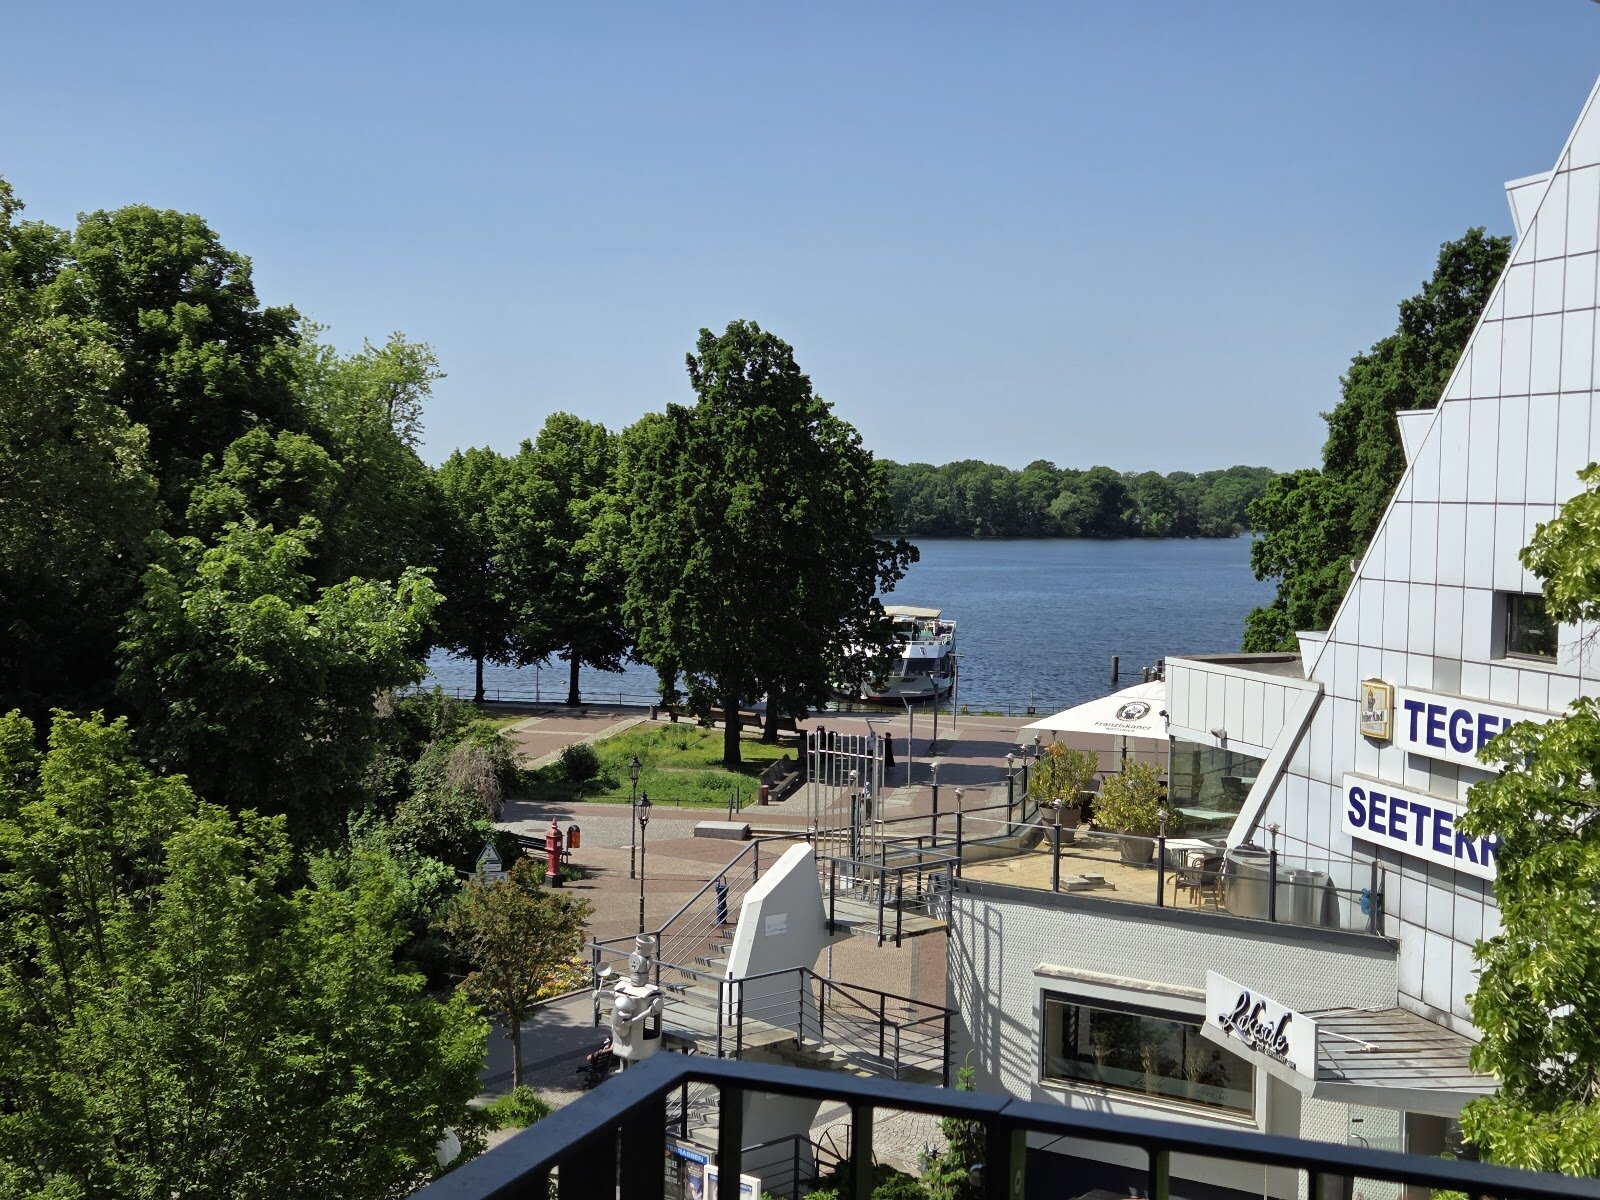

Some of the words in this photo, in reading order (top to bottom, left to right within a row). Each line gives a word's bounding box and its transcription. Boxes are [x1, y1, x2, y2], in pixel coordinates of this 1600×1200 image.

[1094, 720, 1152, 731] Franziskaner
[1404, 699, 1526, 760] TEGE
[1218, 991, 1292, 1054] Lakeside
